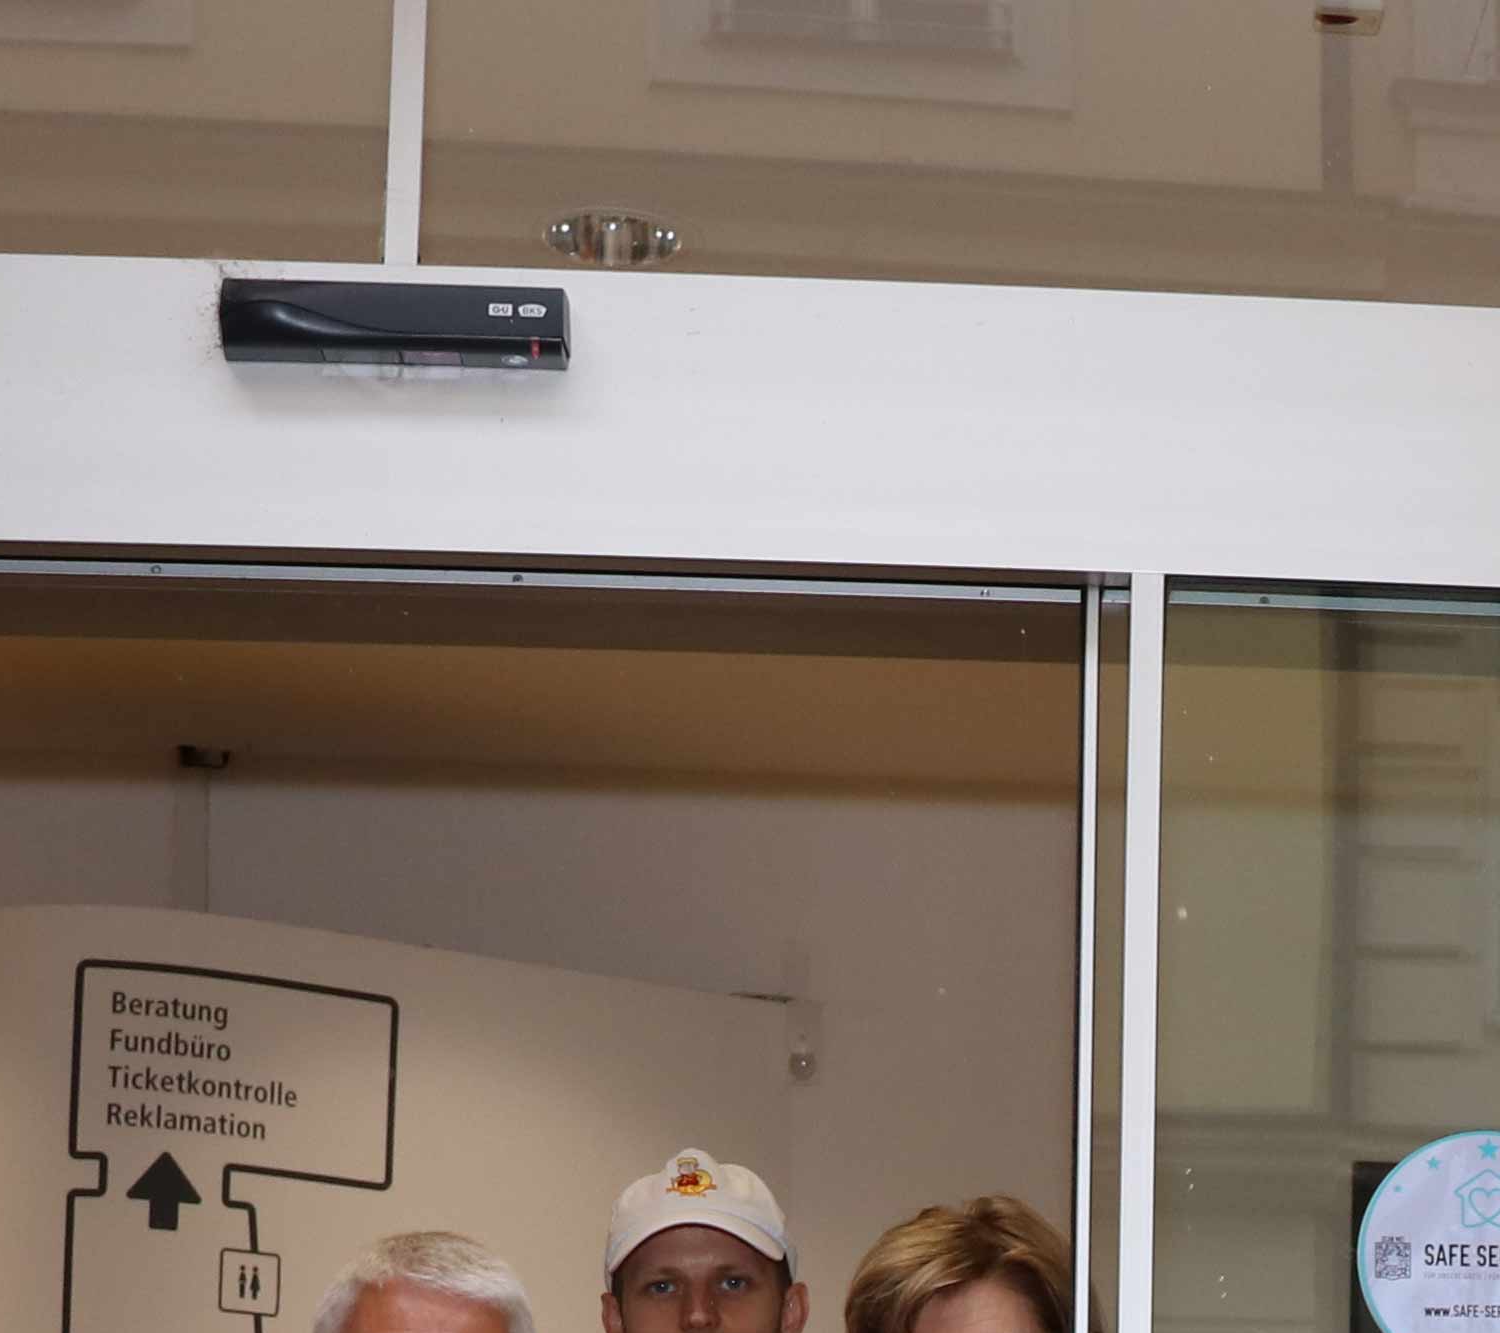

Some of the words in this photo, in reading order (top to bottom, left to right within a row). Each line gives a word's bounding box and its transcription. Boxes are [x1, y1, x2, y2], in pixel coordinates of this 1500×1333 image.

[111, 991, 229, 1031] Beratung
[109, 1028, 232, 1062] Fundbüro
[107, 1065, 298, 1108] Ticketkontrolle
[106, 1103, 267, 1140] Reklamation
[1424, 1244, 1470, 1267] SAFE
